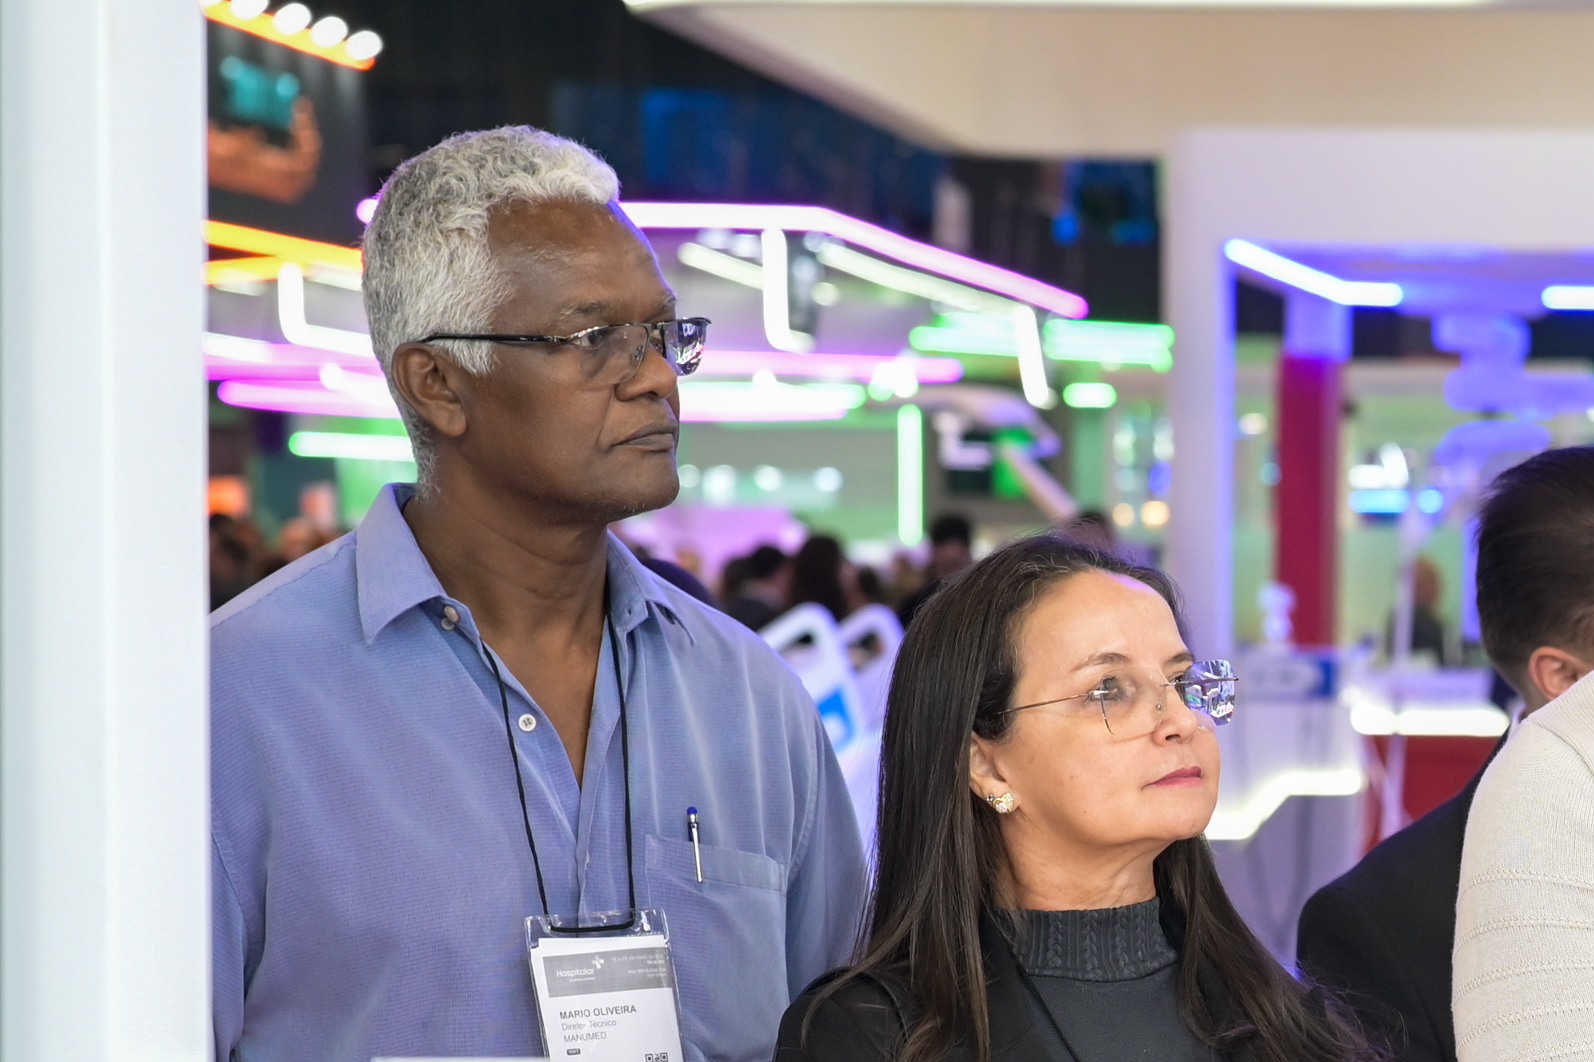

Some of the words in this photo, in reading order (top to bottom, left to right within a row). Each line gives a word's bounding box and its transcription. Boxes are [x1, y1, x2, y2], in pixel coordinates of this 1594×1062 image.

[556, 967, 595, 979] Hospitalar
[559, 1008, 591, 1020] MARIO
[593, 1005, 637, 1017] OLIVEIRA
[561, 1022, 587, 1031] Diretor
[589, 1019, 617, 1029] Técnico
[563, 1031, 607, 1043] MANUMED
